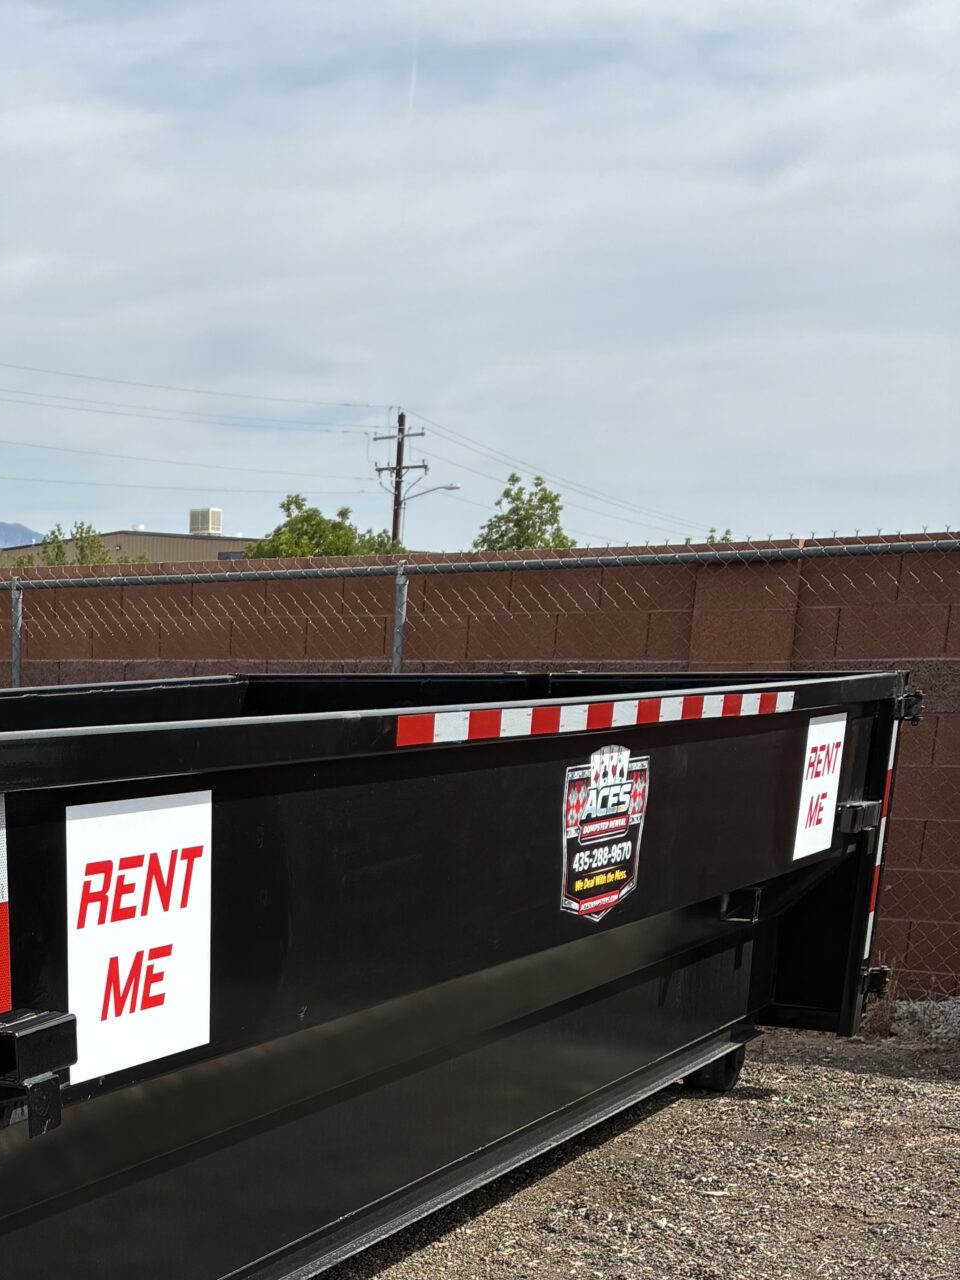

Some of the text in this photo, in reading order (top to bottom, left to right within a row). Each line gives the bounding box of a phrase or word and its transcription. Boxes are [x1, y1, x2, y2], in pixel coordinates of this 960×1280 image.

[805, 741, 841, 781] RENT
[581, 783, 632, 819] ACES
[805, 792, 828, 829] ME
[582, 818, 627, 835] DUMPSTER RENTAL
[572, 841, 632, 872] 435-288-9670
[76, 845, 204, 930] RENT
[574, 880, 583, 892] We
[583, 877, 595, 889] Deal
[595, 874, 606, 886] With
[607, 872, 615, 883] the
[100, 943, 174, 1022] ME
